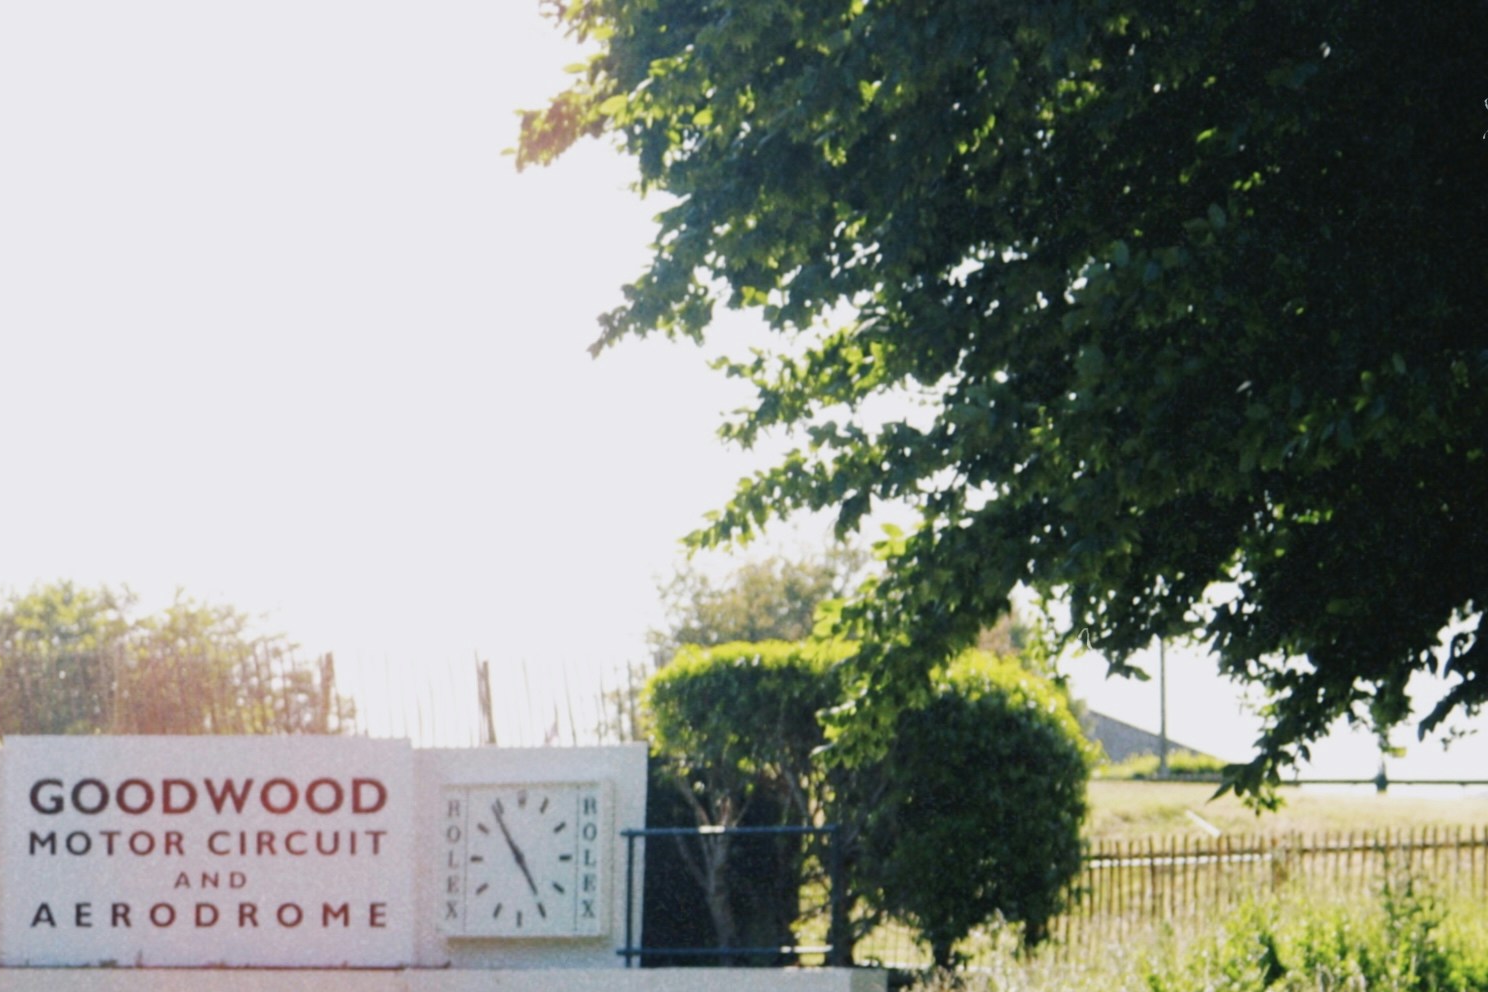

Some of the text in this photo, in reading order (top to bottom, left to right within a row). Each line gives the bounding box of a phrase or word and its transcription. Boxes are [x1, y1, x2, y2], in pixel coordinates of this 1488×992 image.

[30, 777, 387, 815] GOODWOOD
[28, 830, 388, 856] MOTOR CIRCUIT
[445, 799, 461, 919] ROLEX
[581, 796, 598, 918] ROLEX
[173, 871, 248, 889] AND
[30, 902, 388, 928] AERODROME
